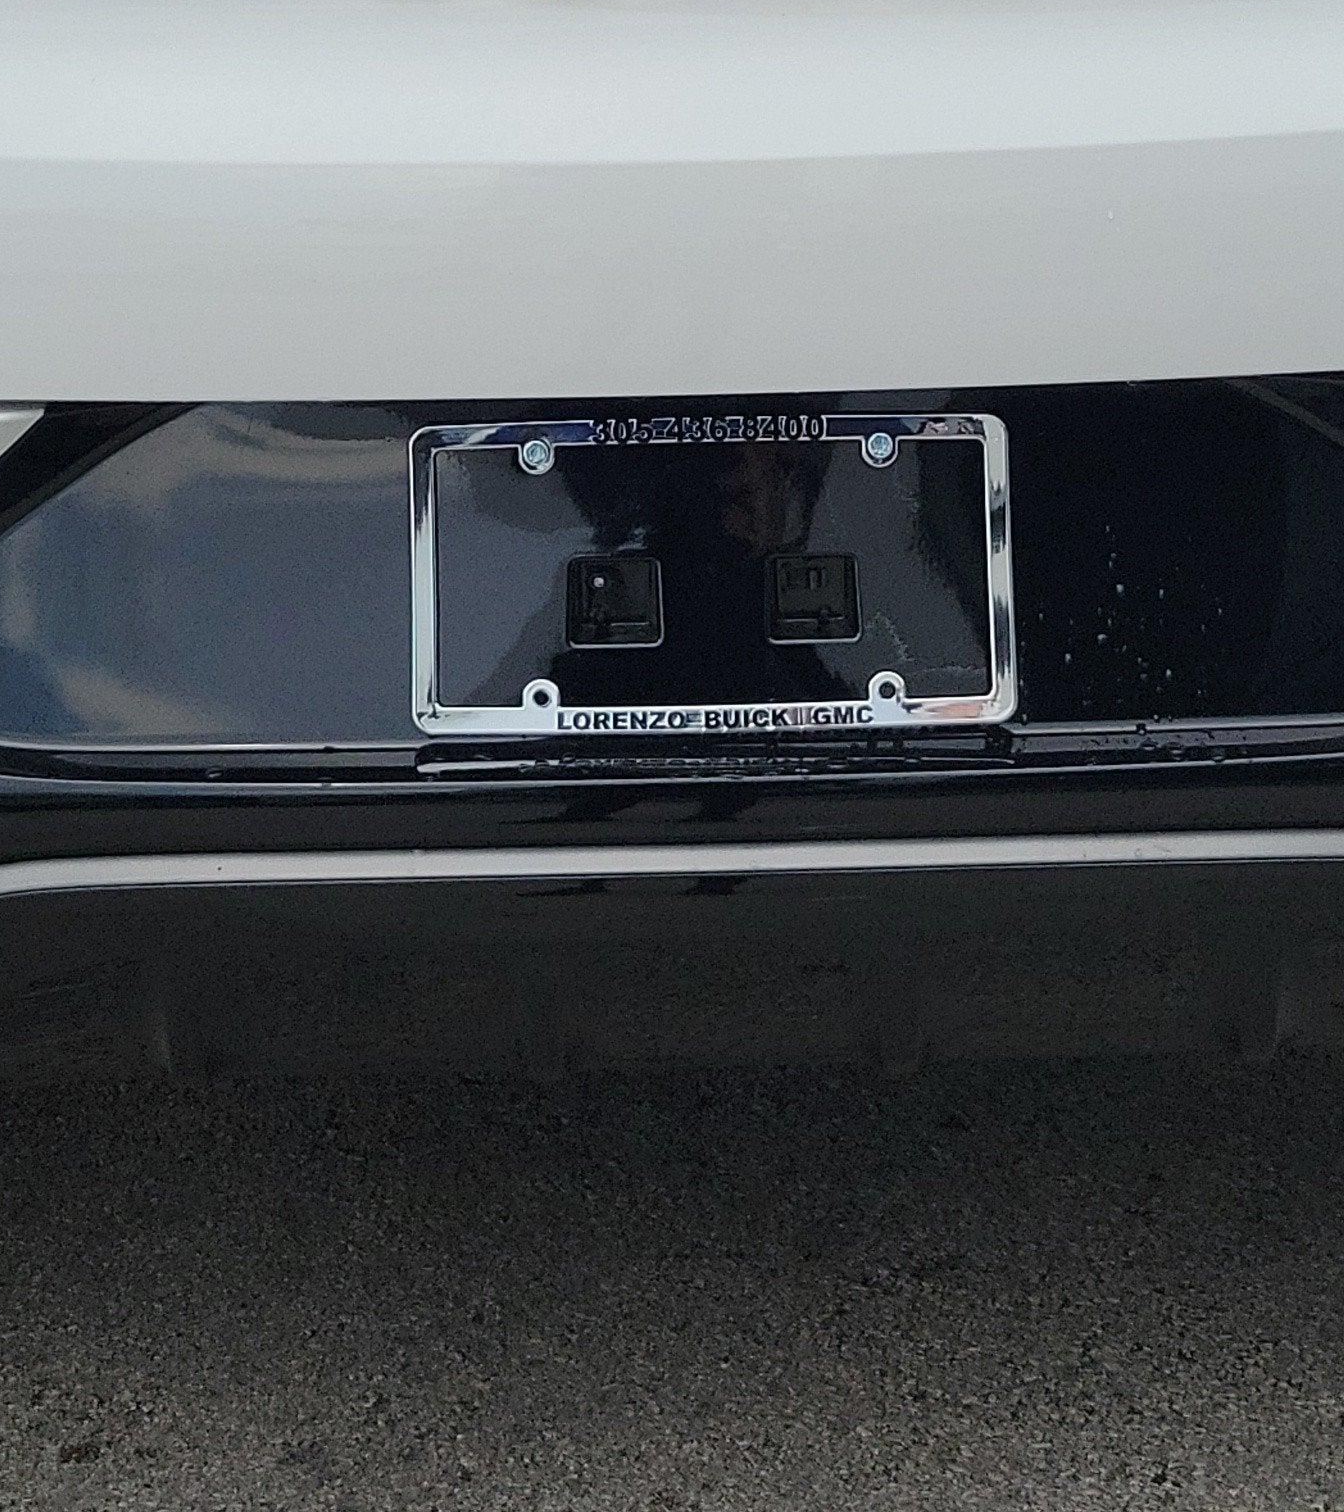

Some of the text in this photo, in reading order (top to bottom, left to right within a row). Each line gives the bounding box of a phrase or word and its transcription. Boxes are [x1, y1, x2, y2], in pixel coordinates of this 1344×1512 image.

[556, 704, 875, 731] LORENZO BUICK GMC
